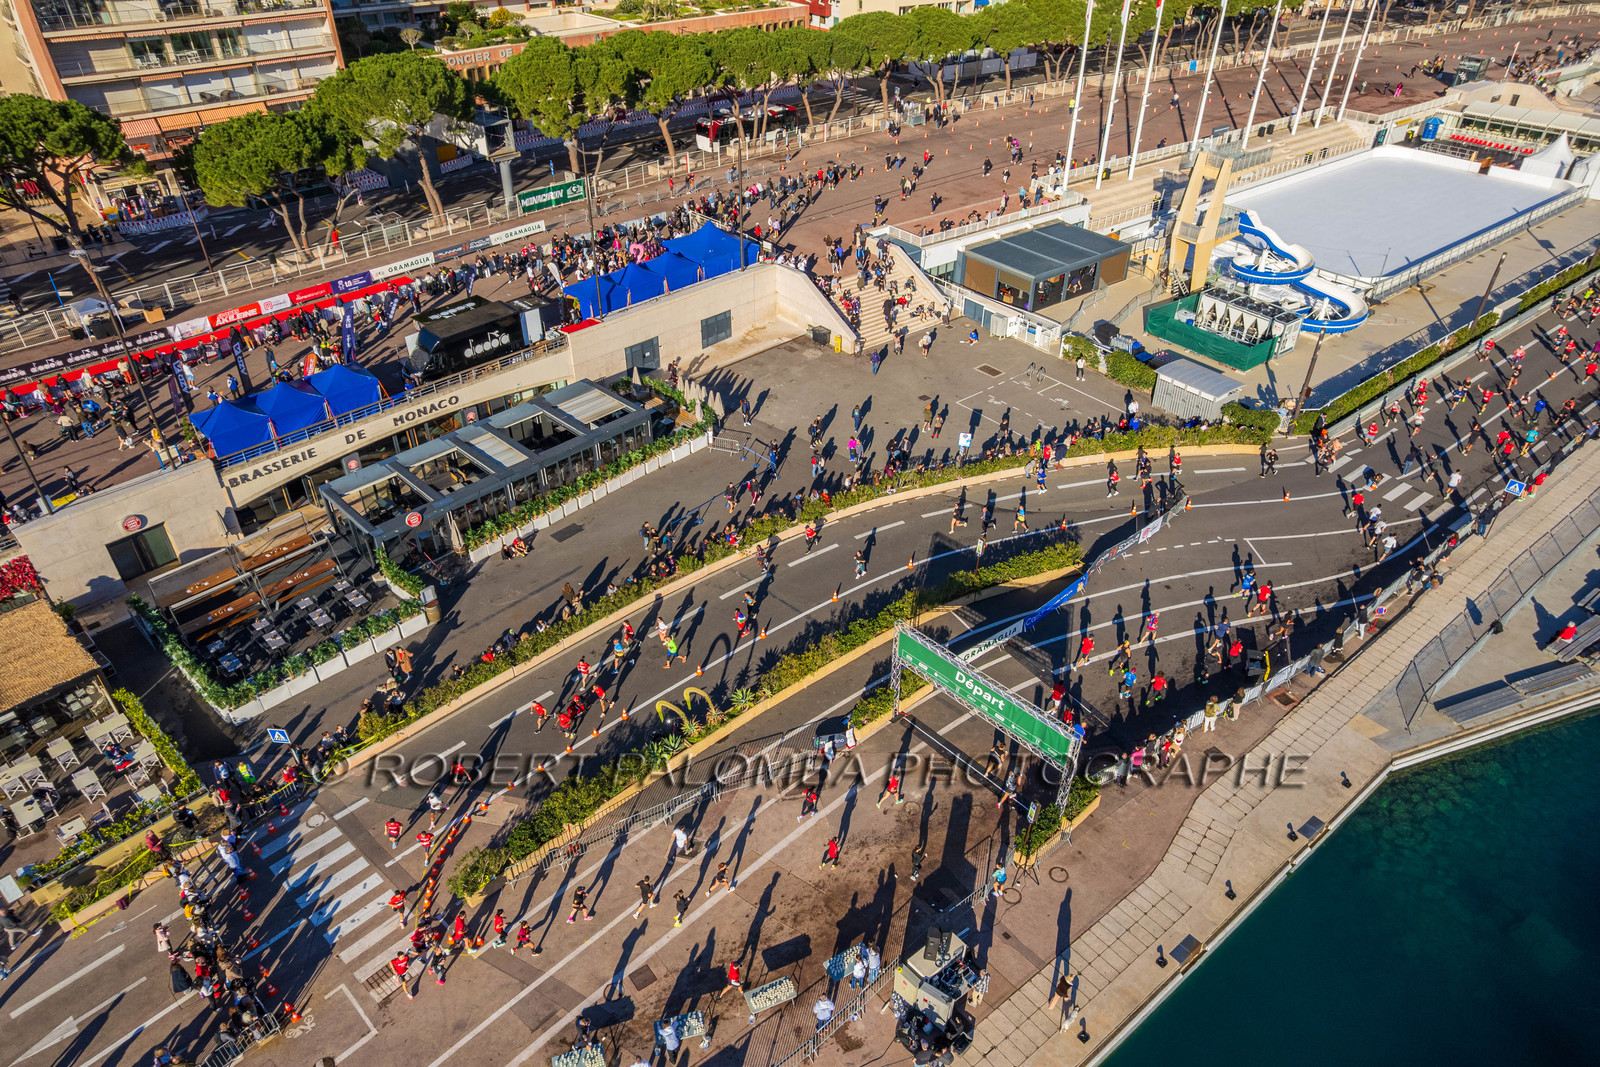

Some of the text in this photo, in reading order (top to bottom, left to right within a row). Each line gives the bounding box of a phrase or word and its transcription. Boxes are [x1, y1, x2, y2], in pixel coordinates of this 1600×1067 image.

[445, 51, 490, 66] ONCIER
[499, 48, 513, 58] DE
[504, 223, 541, 239] GRAMAGLIA
[387, 256, 430, 273] GRAMAGLIA
[464, 330, 510, 358] diadora
[228, 395, 460, 487] BRASSERIE DE MONACO
[963, 627, 1017, 661] GRAMAGLIA
[954, 671, 1005, 711] Départ
